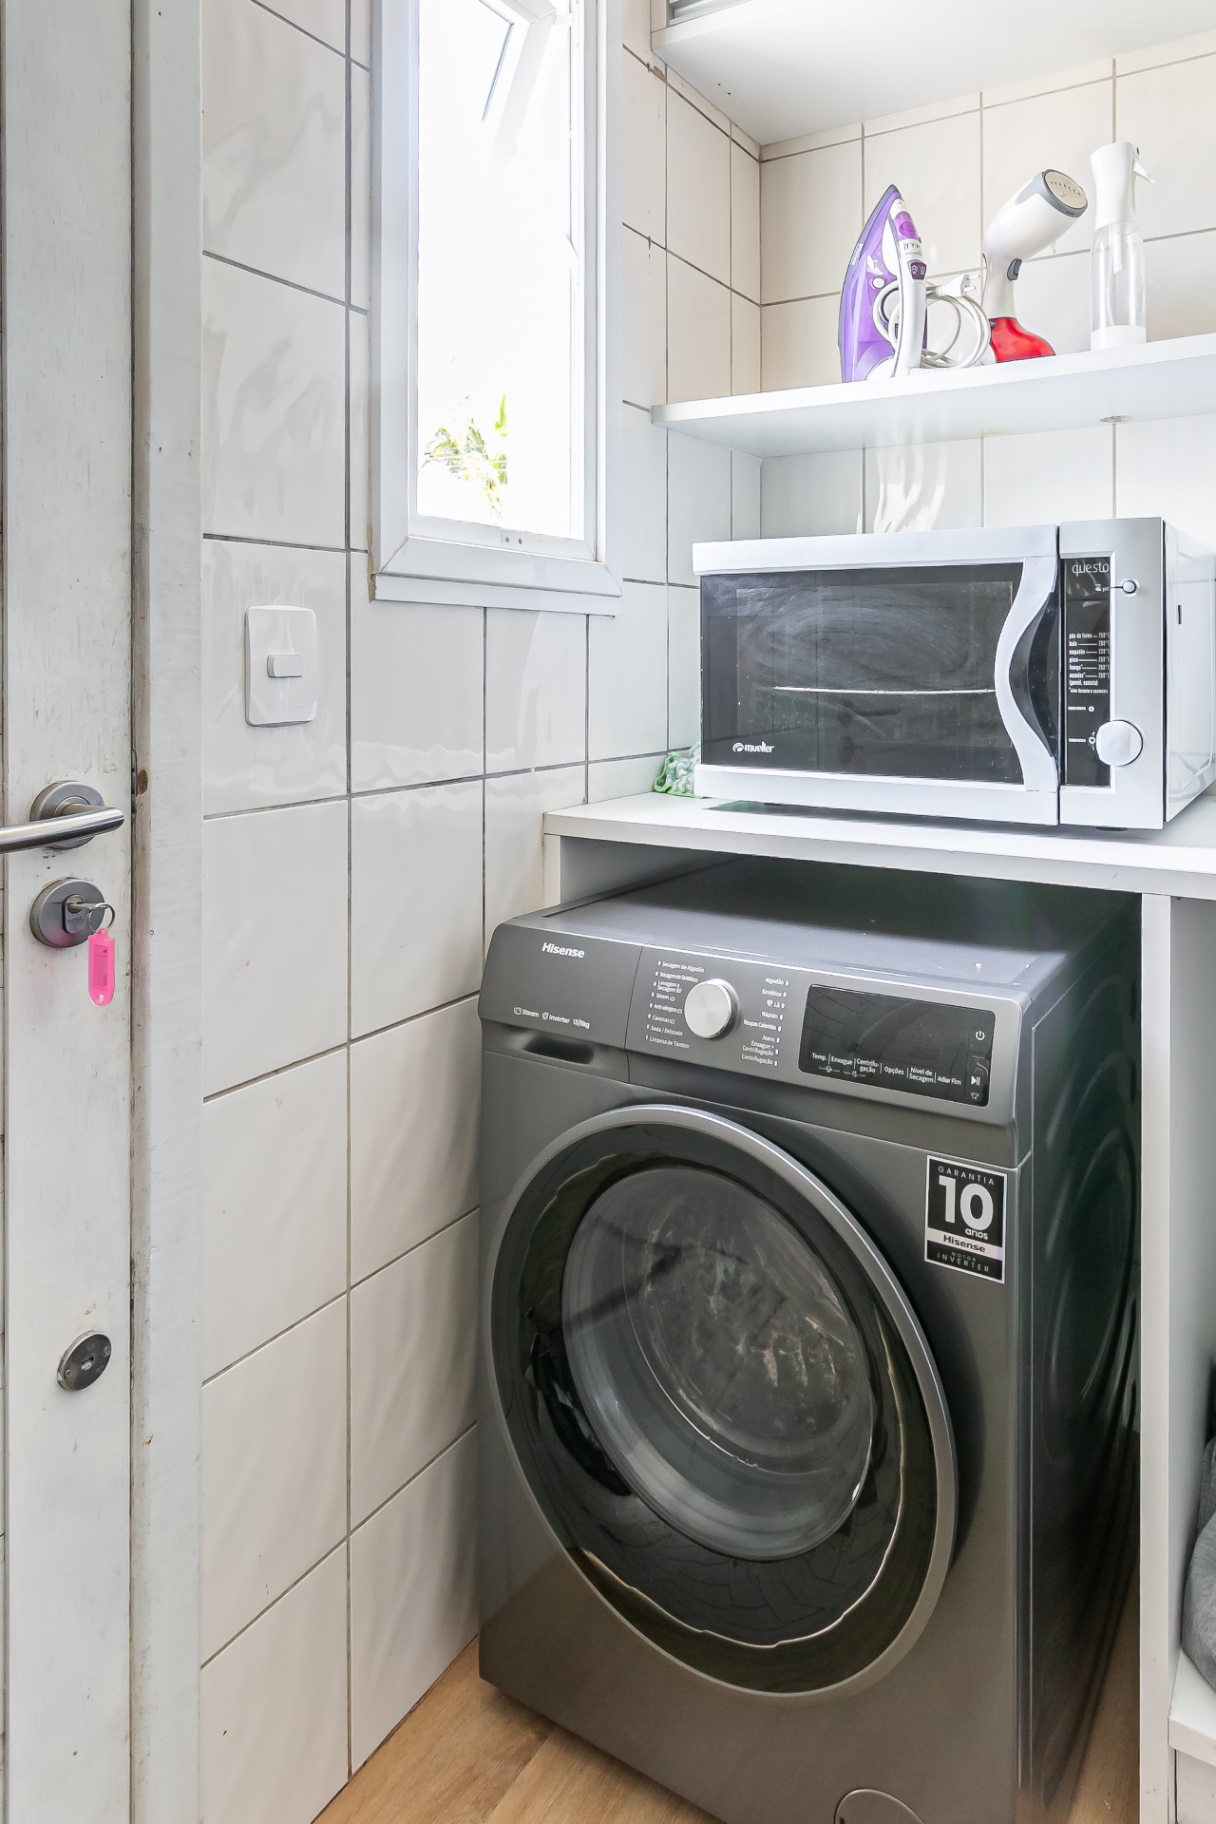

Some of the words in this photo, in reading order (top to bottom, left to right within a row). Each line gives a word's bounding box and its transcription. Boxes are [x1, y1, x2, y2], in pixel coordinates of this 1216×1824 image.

[1071, 562, 1110, 577] questo
[744, 740, 775, 753] mueller
[541, 942, 585, 959] Hisense
[521, 1008, 540, 1018] Steam
[548, 1014, 571, 1025] Inverter
[884, 1066, 905, 1076] Opções
[938, 1175, 994, 1231] 10
[965, 1228, 989, 1241] anos
[943, 1234, 986, 1253] Hisense
[937, 1252, 990, 1273] INVERTER
[951, 1251, 977, 1262] MOTOR
